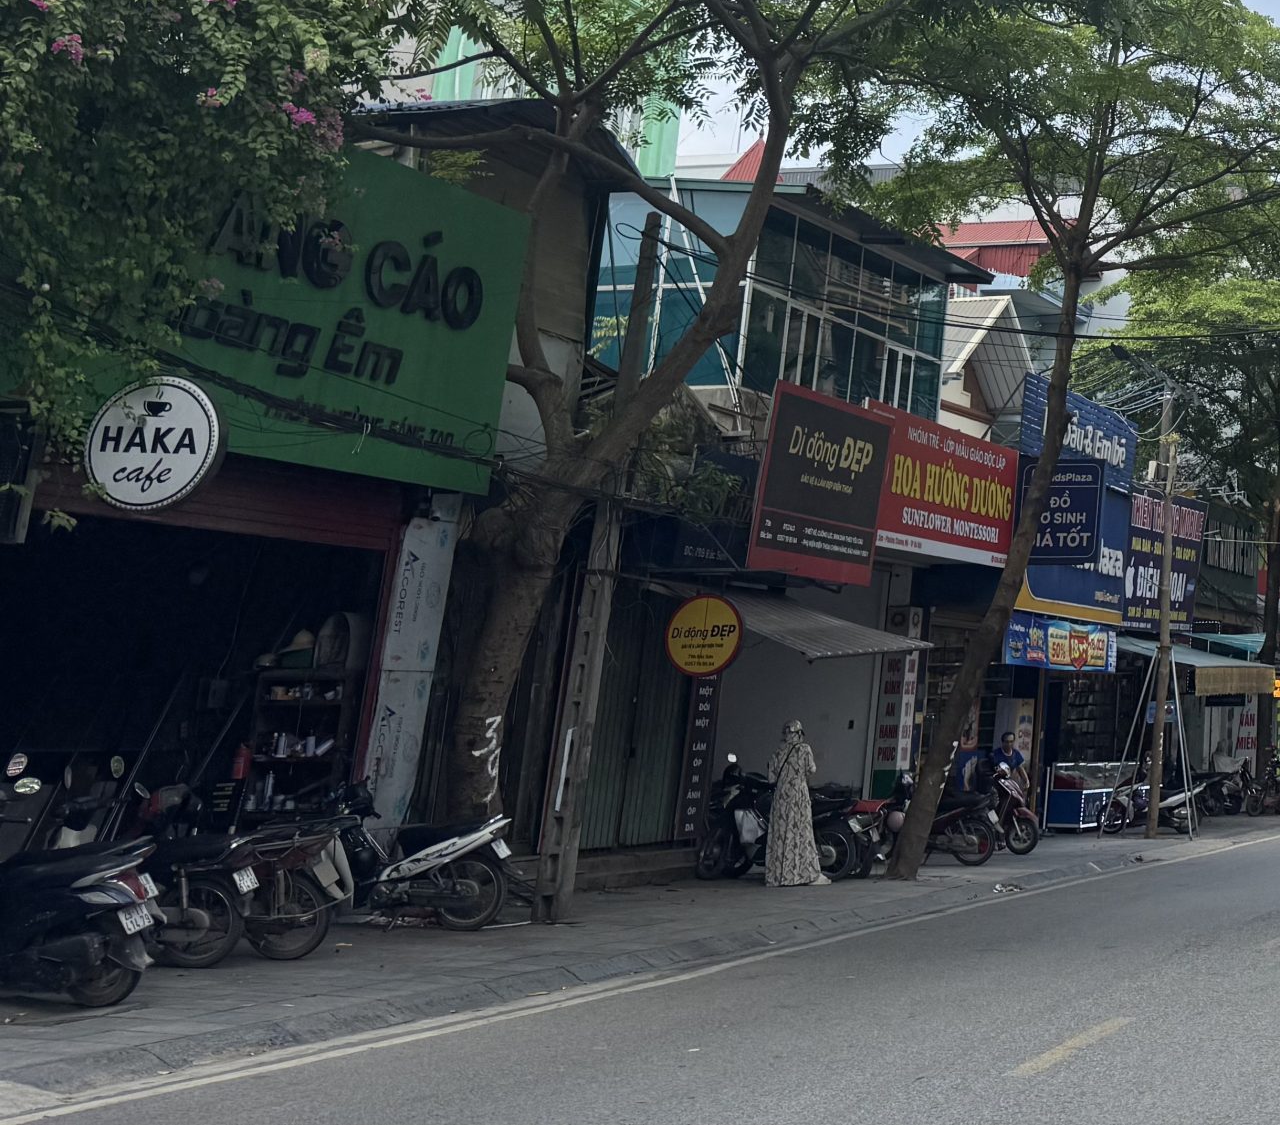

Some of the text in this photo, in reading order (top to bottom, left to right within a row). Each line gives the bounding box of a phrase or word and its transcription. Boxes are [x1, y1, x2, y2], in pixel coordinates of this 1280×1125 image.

[364, 230, 483, 331] CÁO
[178, 288, 404, 386] oàng Êm
[99, 425, 197, 455] HAKA
[788, 425, 874, 481] Di động ĐẸP
[907, 426, 1007, 473] NHÓM TRẺ LỚP MẪU GIÁO ĐỘC LẬP
[112, 457, 173, 494] cafe
[891, 453, 1012, 522] HOA HƯỚNG DƯƠNG
[1050, 489, 1071, 508] ĐỒ
[902, 506, 1000, 544] SUNFLOWER MONTESSORI
[1053, 512, 1087, 524] SINH
[1055, 525, 1092, 548] TỐT
[1136, 560, 1161, 606] ĐIỆN
[671, 624, 737, 643] Di động ĐẸP
[698, 686, 714, 698] MỘT
[695, 718, 710, 728] MỘT
